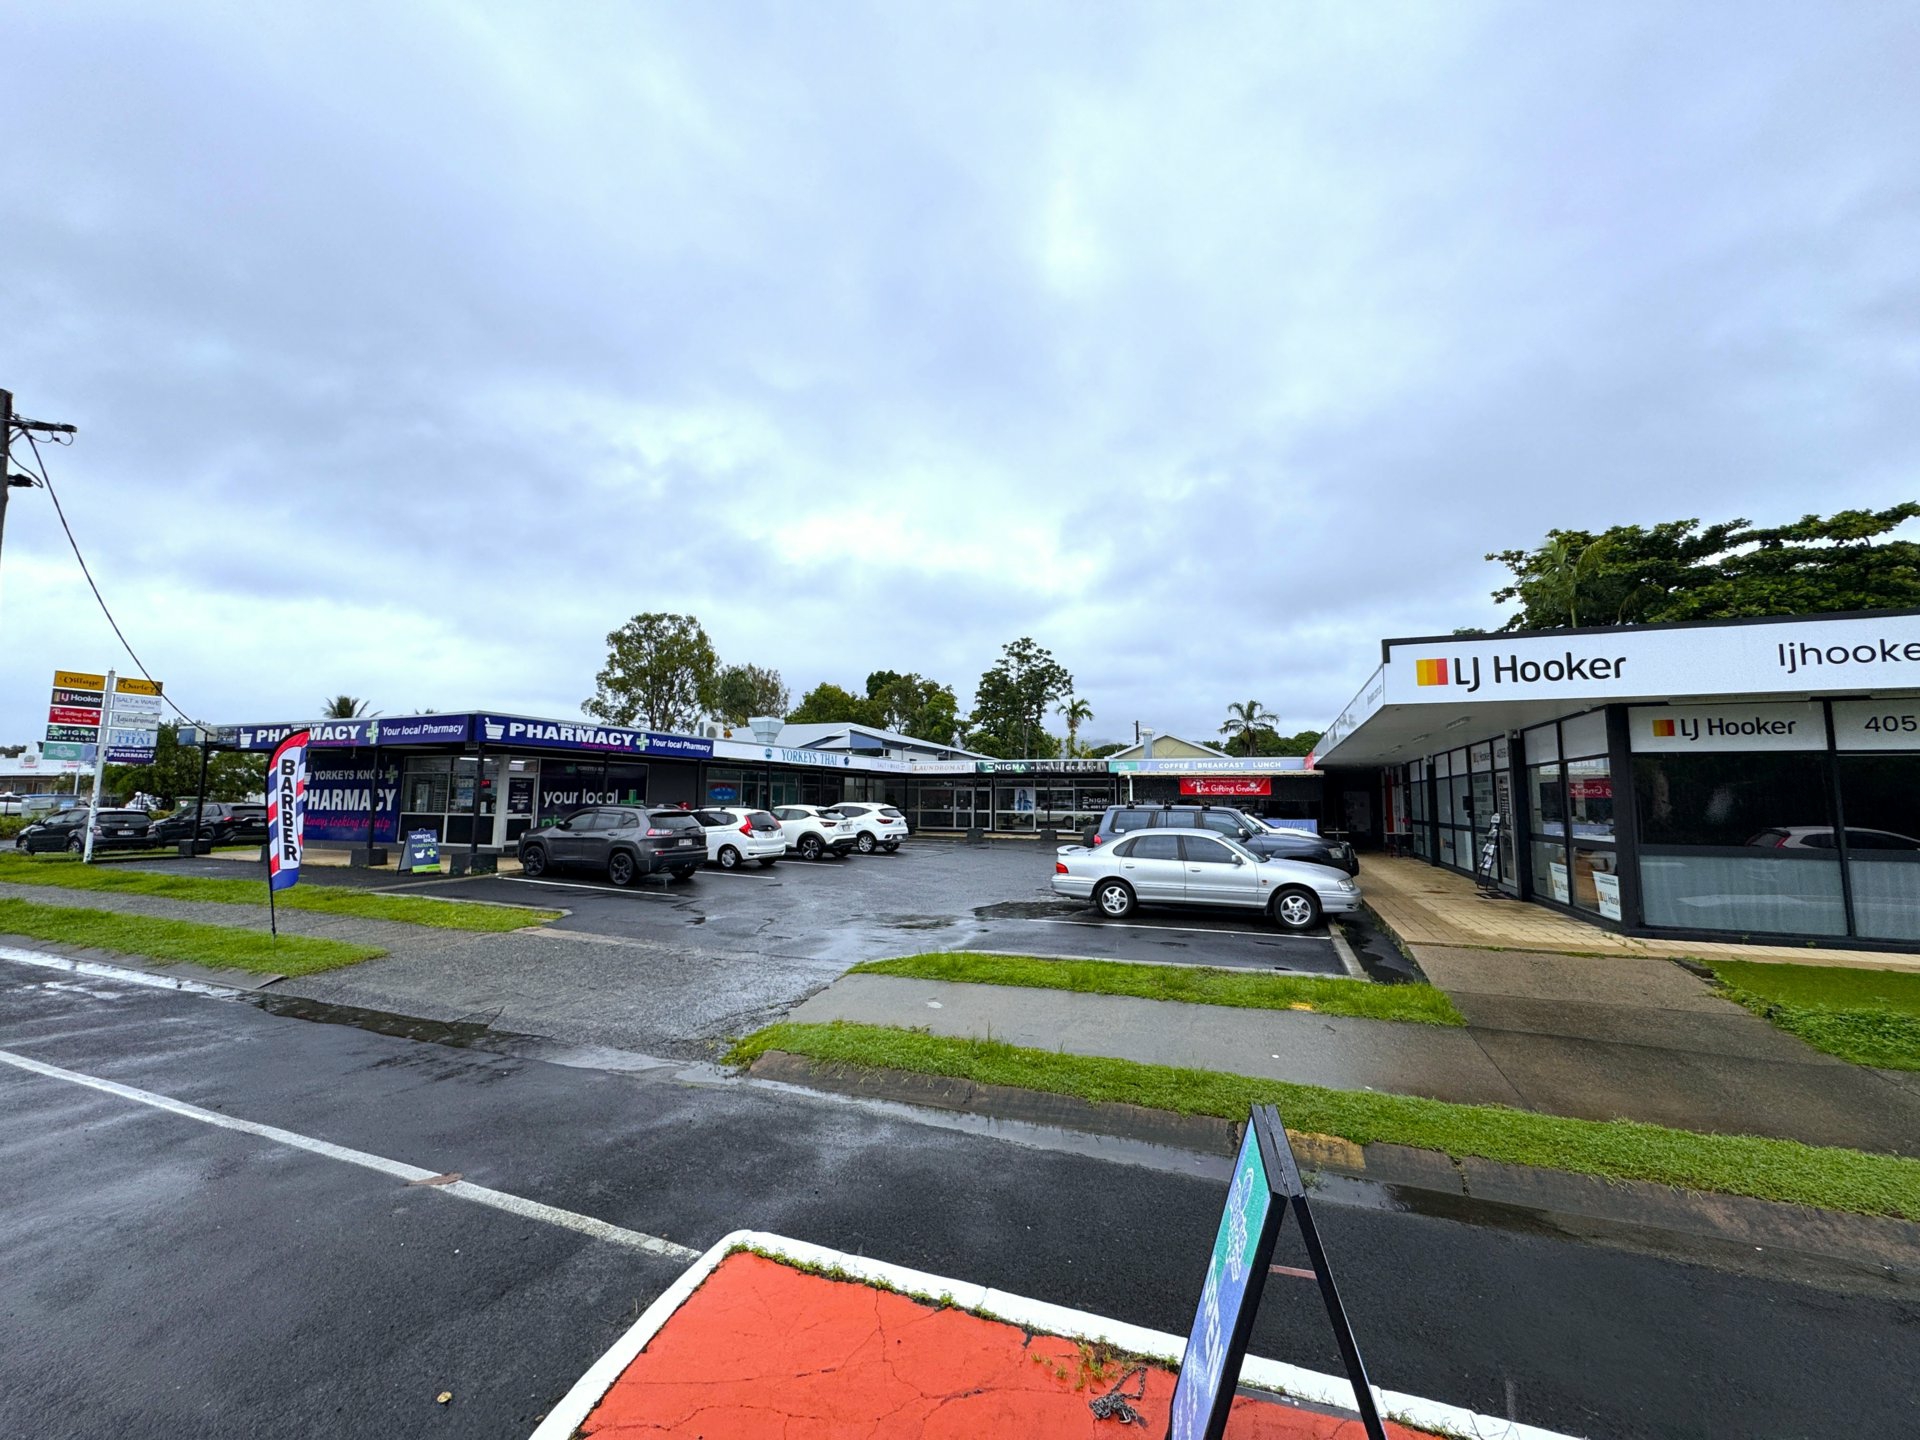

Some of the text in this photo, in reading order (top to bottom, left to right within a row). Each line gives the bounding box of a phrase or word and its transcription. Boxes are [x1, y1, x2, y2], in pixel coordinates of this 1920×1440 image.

[1454, 652, 1626, 692] LJ Hooker
[71, 694, 102, 703] Hooker
[48, 727, 96, 737] ENIGMA
[382, 724, 464, 736] Your local Pharmacy
[1681, 716, 1796, 741] LJ Hooker
[509, 722, 634, 747] PHARMACY
[115, 736, 151, 745] THAI
[652, 738, 711, 752] Your local Pharmacy
[782, 749, 838, 766] YORKEYS THAI
[914, 764, 965, 772] LAUNDROMAT
[987, 762, 1026, 772] ENIGMA
[1197, 761, 1245, 769] BREAKFAST
[1253, 761, 1281, 769] LUNCH
[314, 770, 355, 780] YORKEYS
[1211, 783, 1235, 794] Gifting
[543, 790, 579, 808] your
[582, 788, 619, 805] local
[280, 758, 298, 862] BARBER
